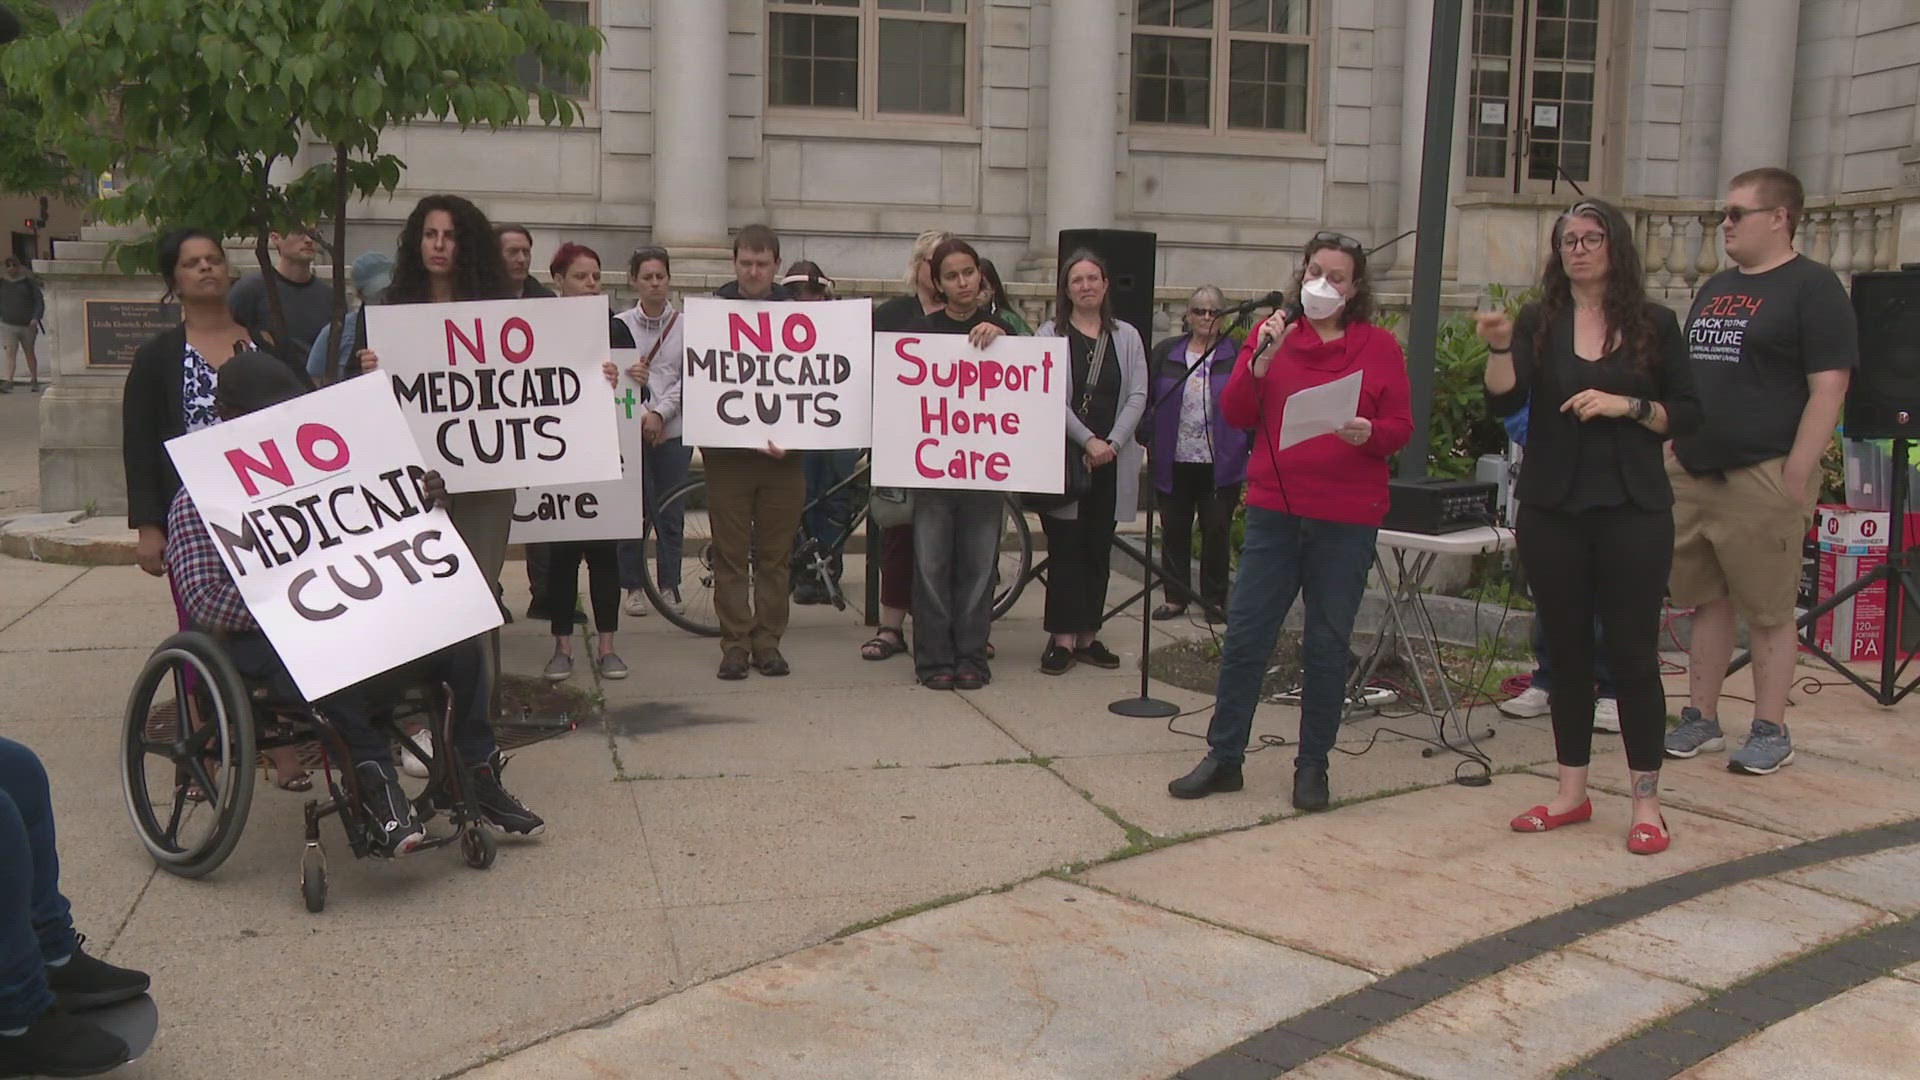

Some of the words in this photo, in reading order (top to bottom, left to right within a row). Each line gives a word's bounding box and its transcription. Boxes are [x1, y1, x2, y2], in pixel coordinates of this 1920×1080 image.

[1692, 318, 1724, 329] BACK
[1700, 295, 1763, 316] 2024
[445, 317, 534, 366] NO
[729, 312, 816, 354] NO
[1689, 329, 1743, 346] FUTURE
[687, 348, 851, 387] MEDICAID
[895, 338, 1054, 402] Support
[392, 367, 580, 414] MEDICAID
[717, 391, 841, 427] CUTS
[921, 397, 1020, 436] Home
[225, 423, 349, 497] NO
[437, 415, 566, 468] CUTS
[915, 438, 1010, 482] Care
[210, 465, 434, 577] MEDICAID
[288, 531, 459, 622] CUTS
[1855, 621, 1871, 631] 120
[1854, 639, 1878, 656] PA
